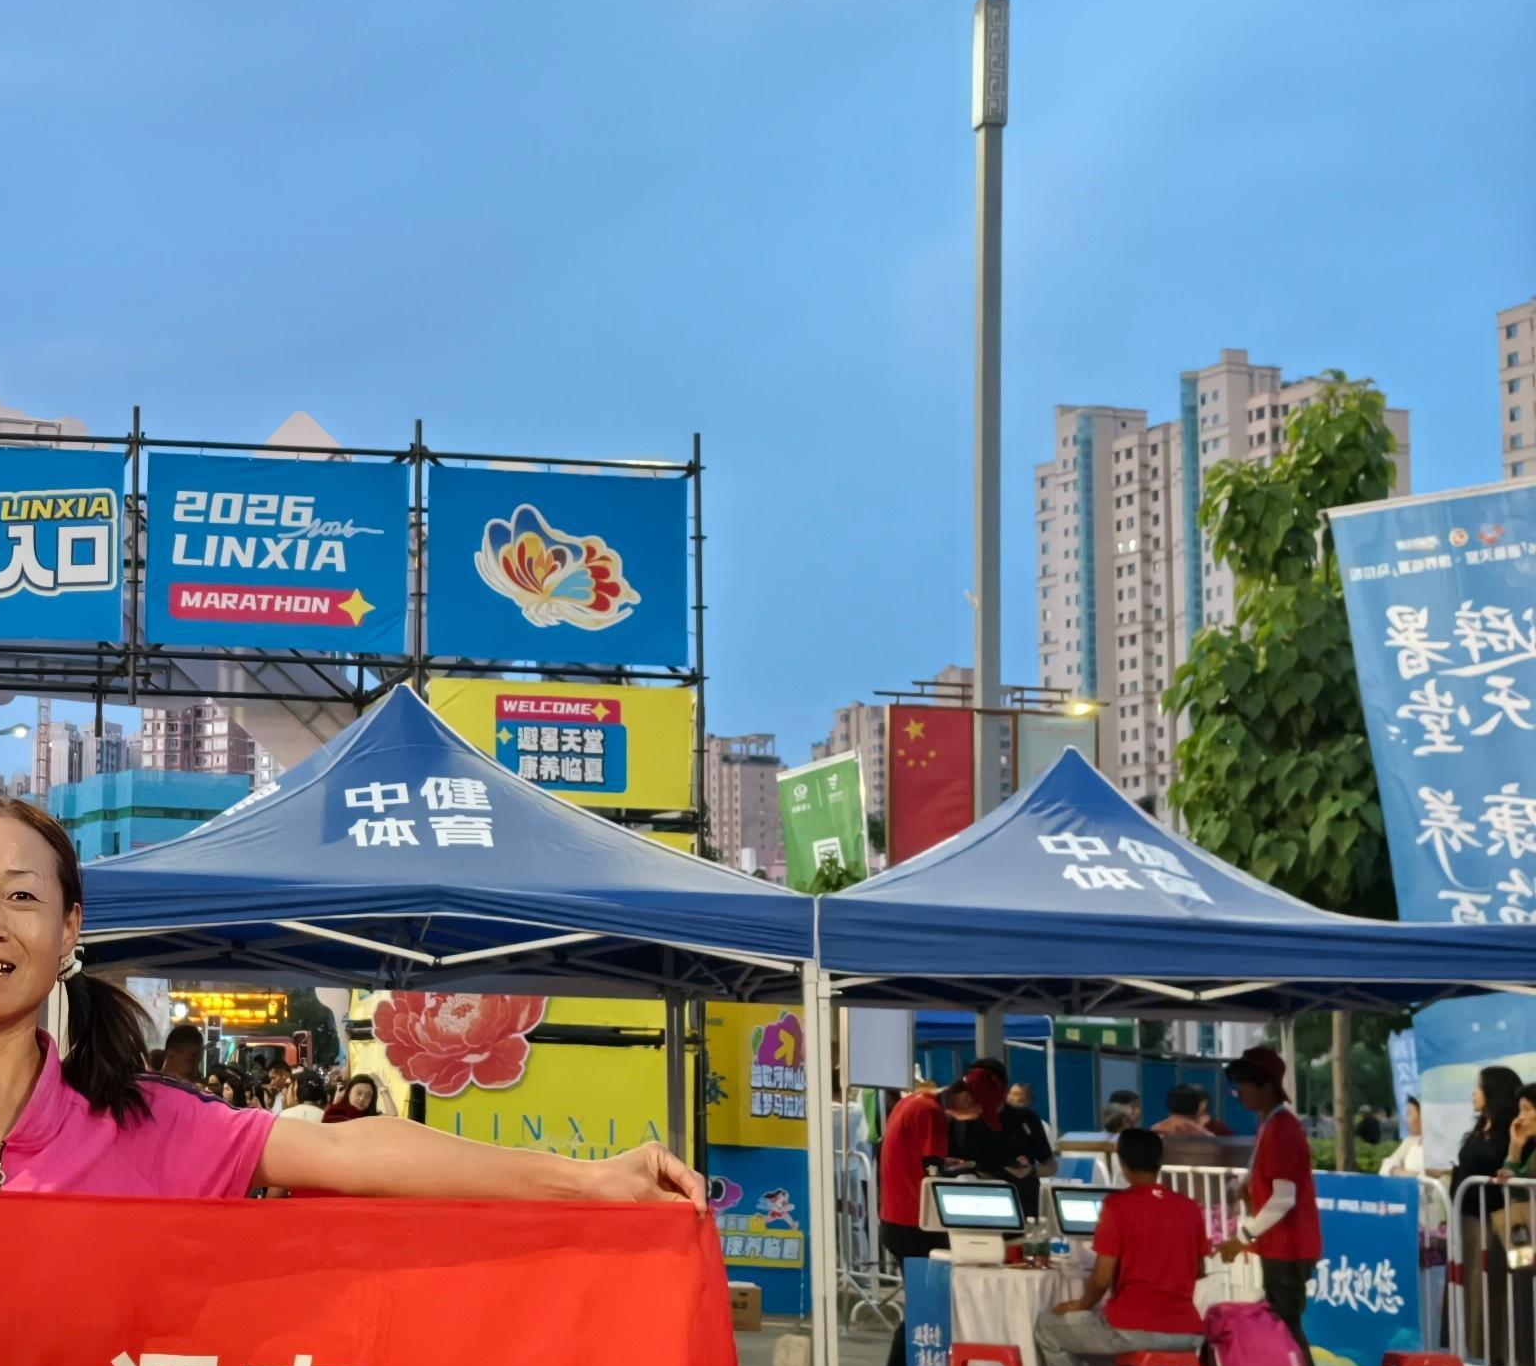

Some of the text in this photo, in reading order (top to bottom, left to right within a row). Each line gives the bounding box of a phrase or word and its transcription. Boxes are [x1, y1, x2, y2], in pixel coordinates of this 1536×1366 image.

[1, 497, 110, 521] LINXIA
[173, 490, 315, 528] 2026
[172, 534, 346, 572] LINXIA
[180, 591, 330, 614] MARATHON
[503, 700, 592, 716] WELCOME
[517, 726, 604, 754] 避暑天堂
[518, 755, 604, 783] 康养临夏
[345, 777, 492, 813] 中健
[348, 815, 494, 847] 体育
